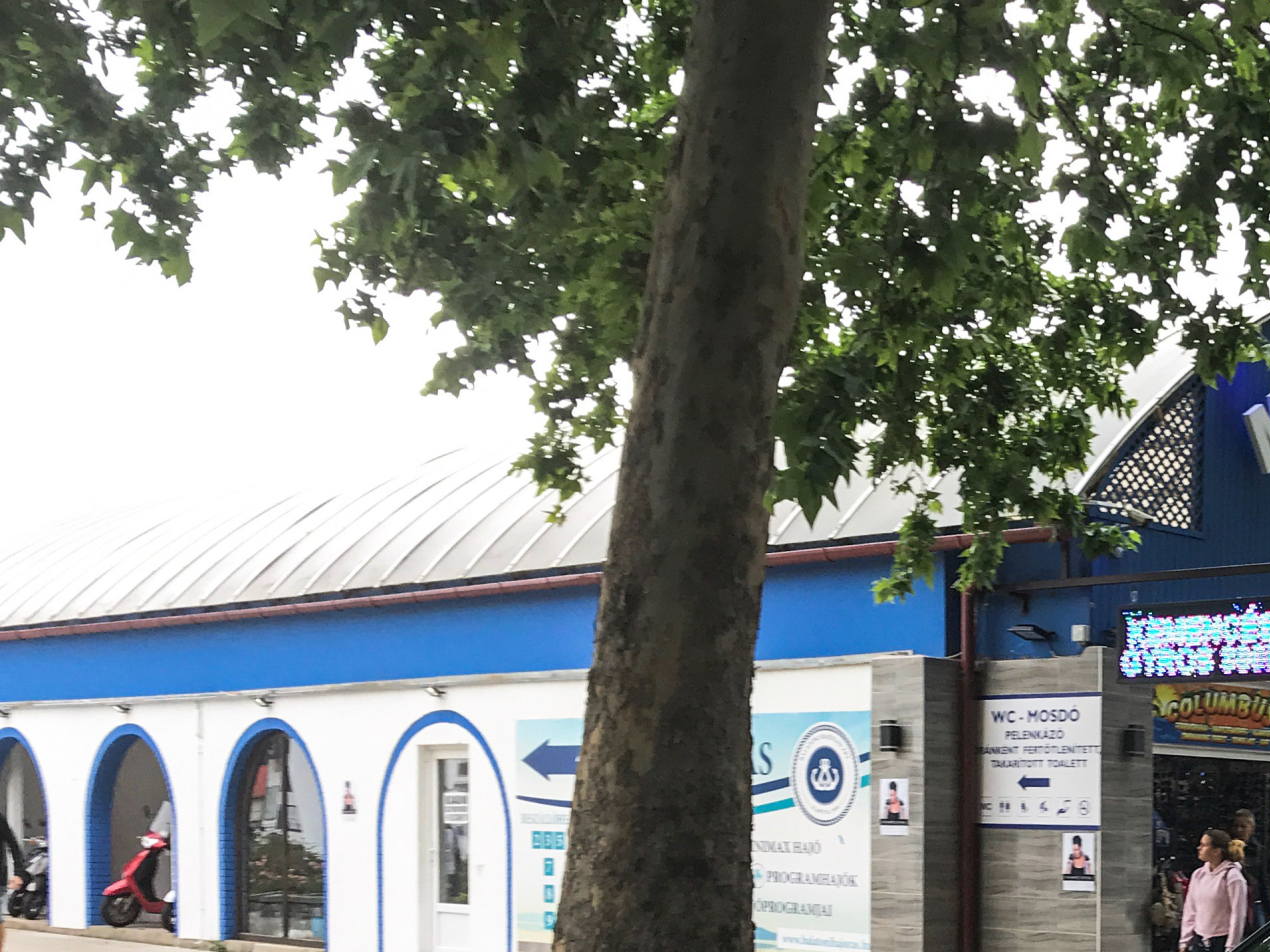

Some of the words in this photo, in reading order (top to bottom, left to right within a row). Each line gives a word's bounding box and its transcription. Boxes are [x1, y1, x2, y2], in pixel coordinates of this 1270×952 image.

[991, 709, 1016, 723] WC
[1027, 704, 1080, 722] MOSDÓ
[1005, 727, 1065, 740] PELENKÁZÓ
